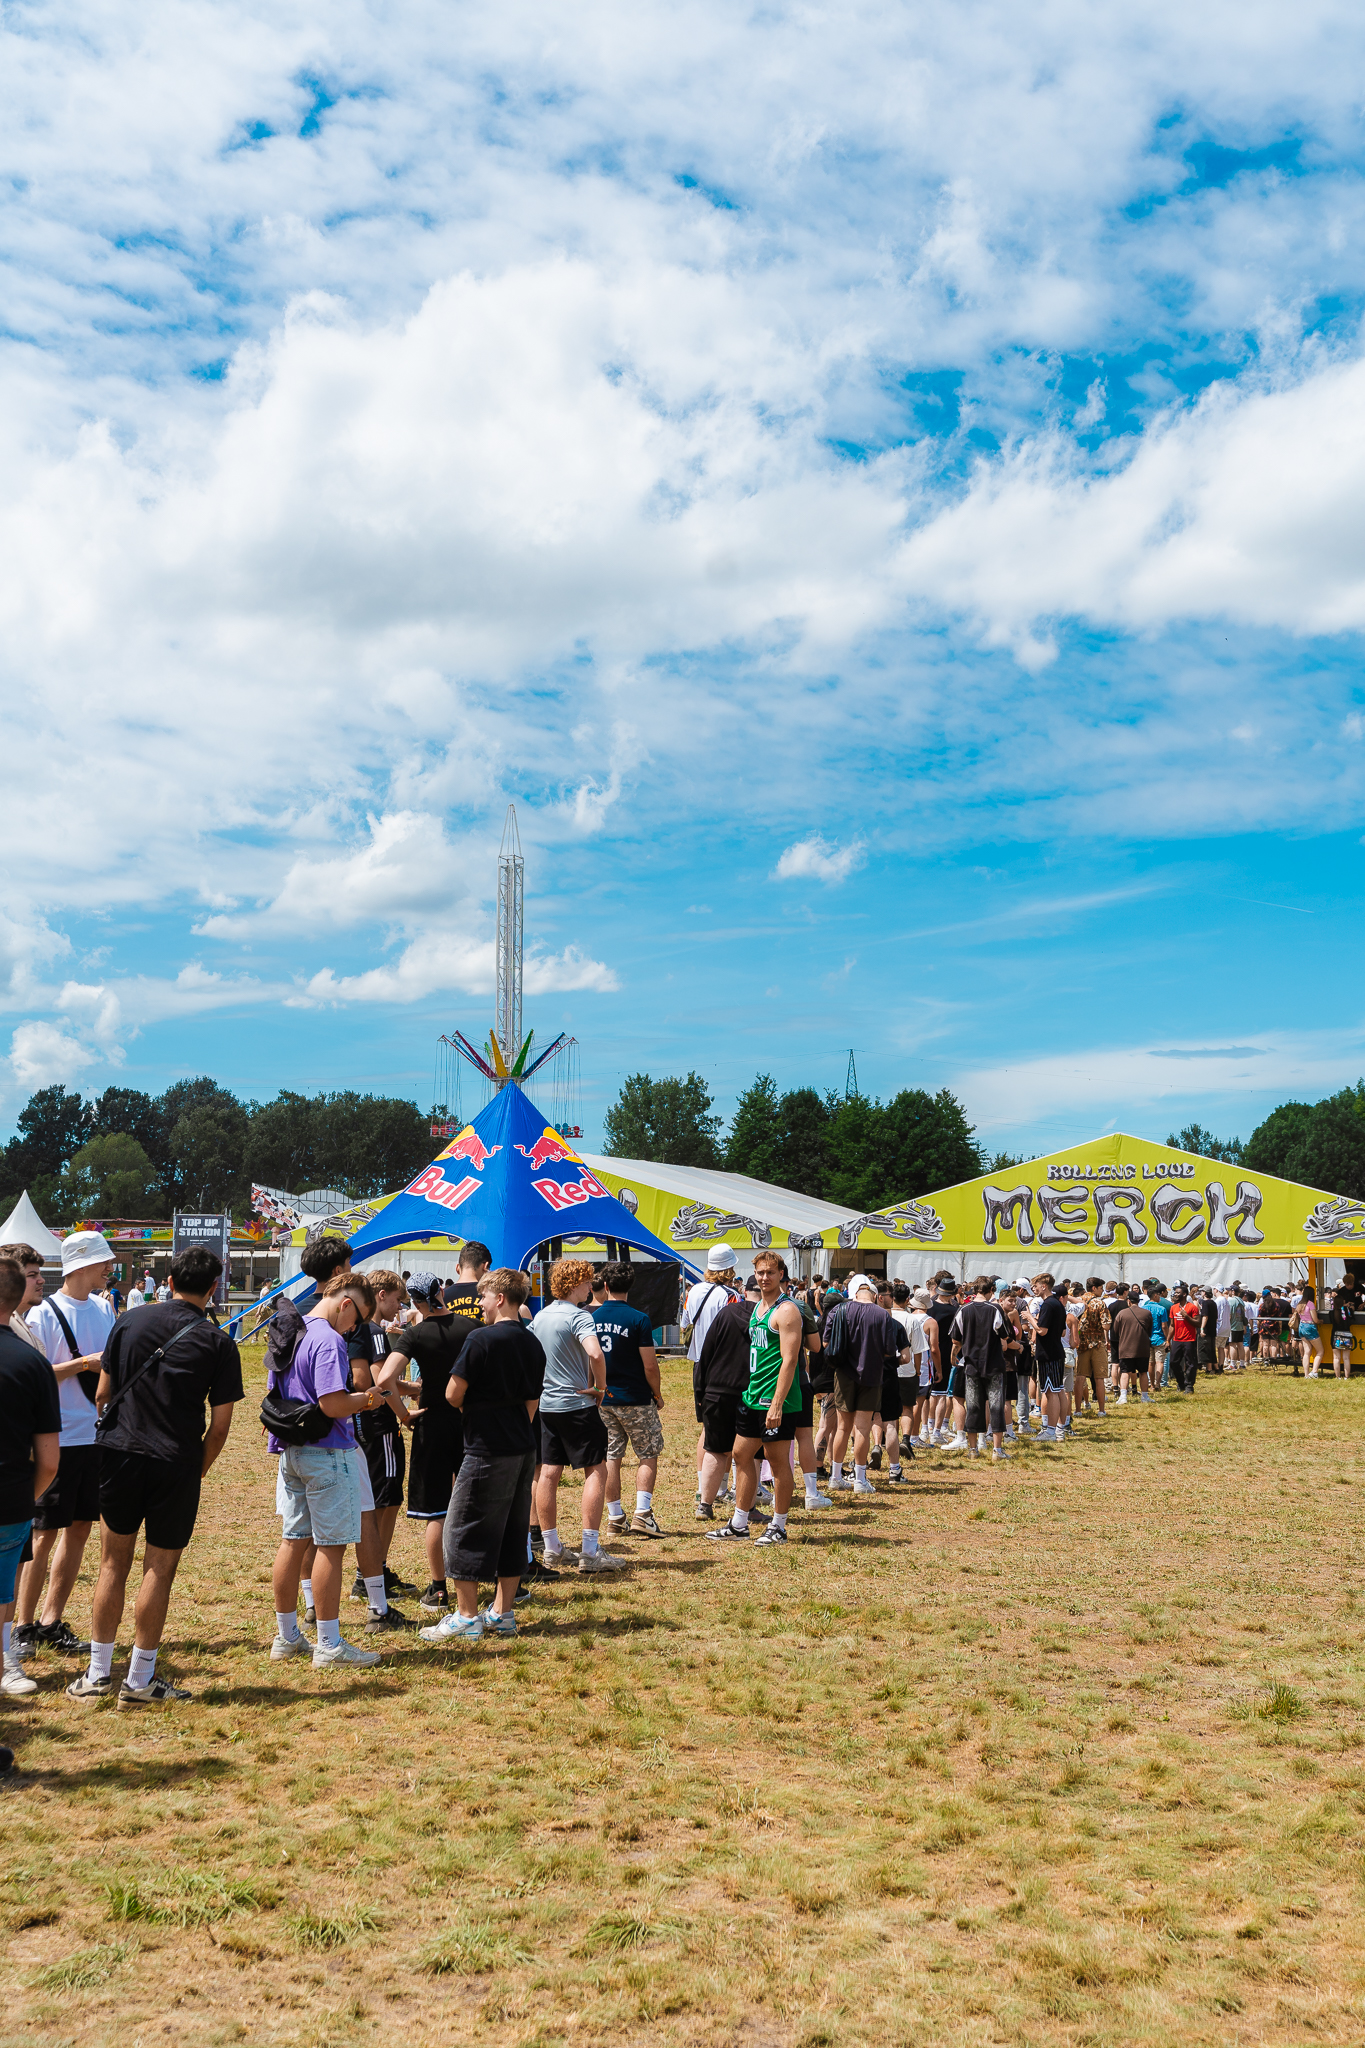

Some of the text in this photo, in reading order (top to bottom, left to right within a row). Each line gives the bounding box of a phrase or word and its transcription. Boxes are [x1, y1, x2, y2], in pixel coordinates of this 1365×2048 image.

[1047, 1163, 1195, 1181] ROLLING LOUD
[405, 1166, 482, 1210] Bull
[531, 1167, 609, 1211] Red
[181, 1218, 219, 1227] TOP UP
[981, 1181, 1265, 1247] MERCH
[178, 1227, 221, 1237] STATION
[447, 1296, 473, 1311] LING
[595, 1322, 629, 1338] ENNA
[600, 1334, 613, 1353] 3
